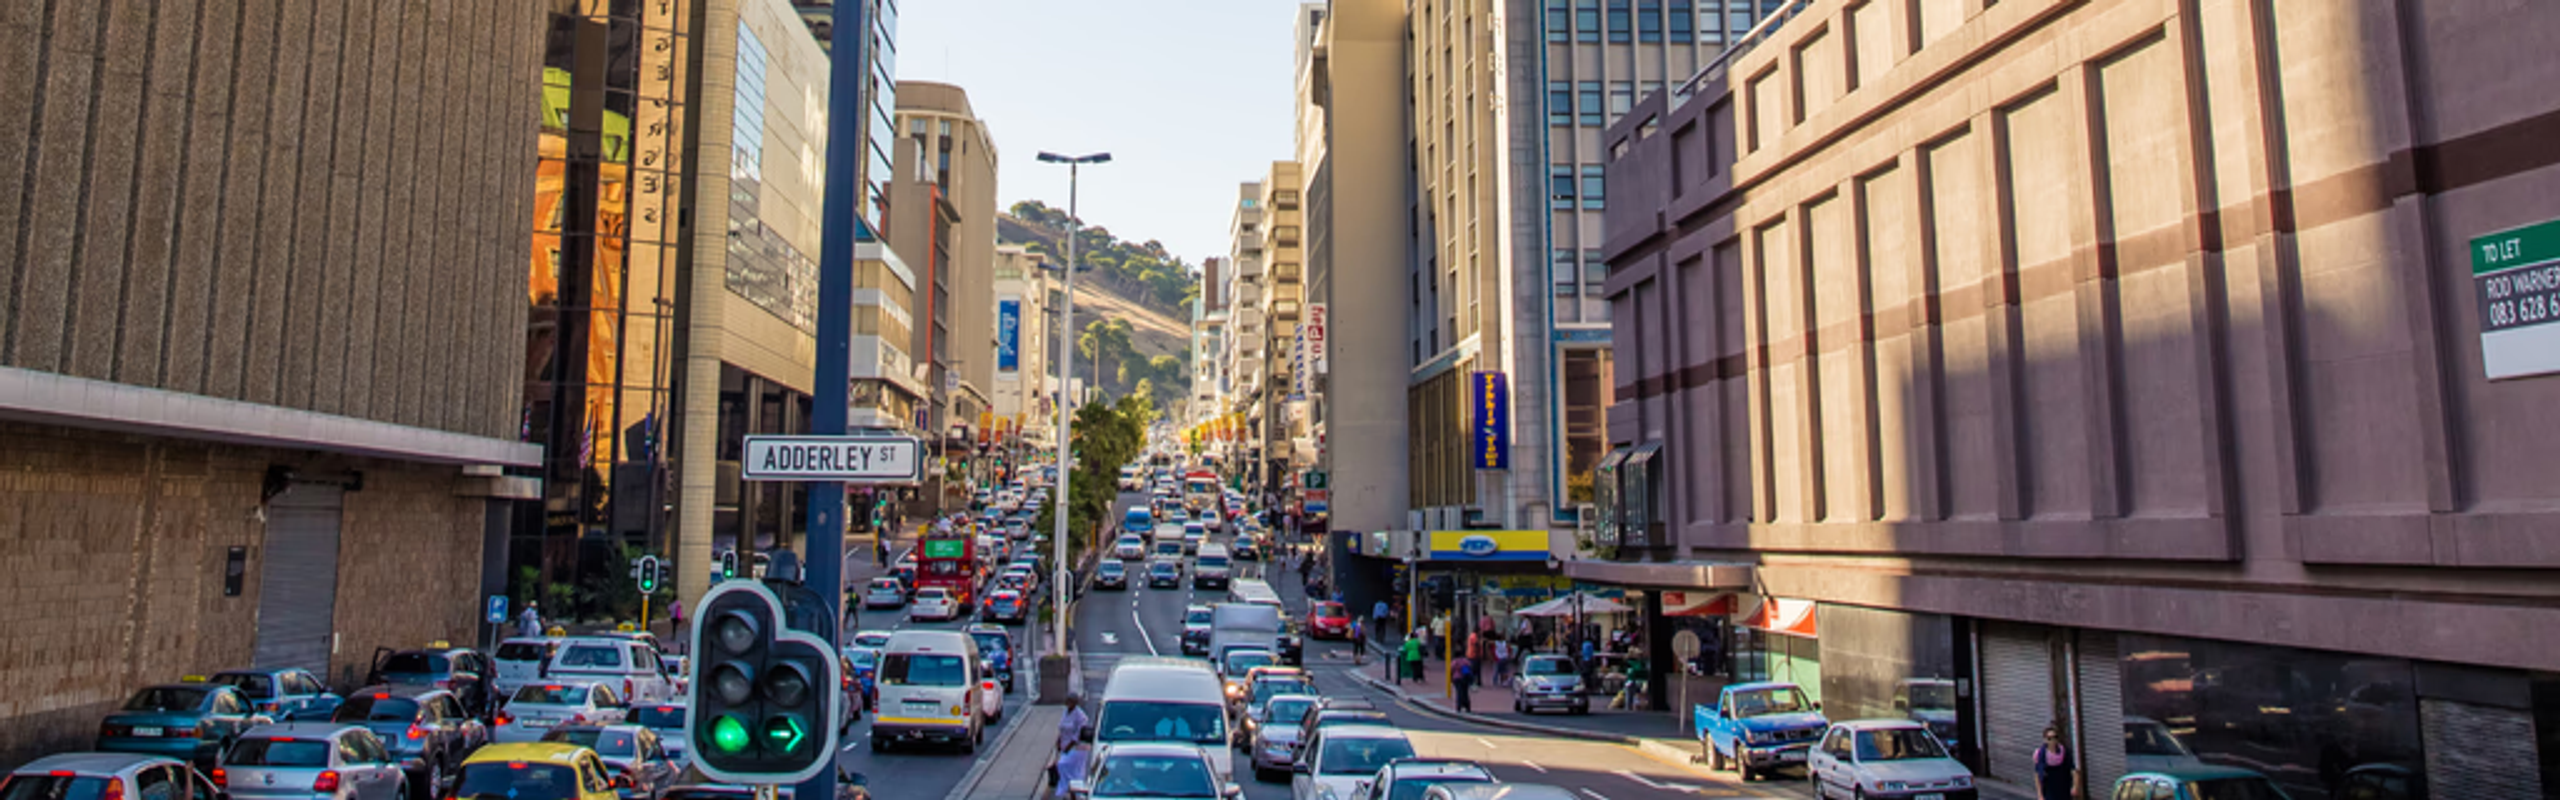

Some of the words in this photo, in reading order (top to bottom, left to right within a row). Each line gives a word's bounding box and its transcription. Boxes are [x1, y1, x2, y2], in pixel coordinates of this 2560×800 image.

[2482, 244, 2498, 263] TO
[2500, 238, 2521, 261] LET
[2486, 276, 2511, 299] ROD
[2512, 265, 2560, 293] WARNER
[2490, 301, 2516, 326] 083
[2520, 295, 2546, 321] 628
[2550, 292, 2560, 317] 6
[763, 445, 872, 471] ADDERLEY
[880, 446, 896, 462] ST
[1310, 473, 1321, 488] P
